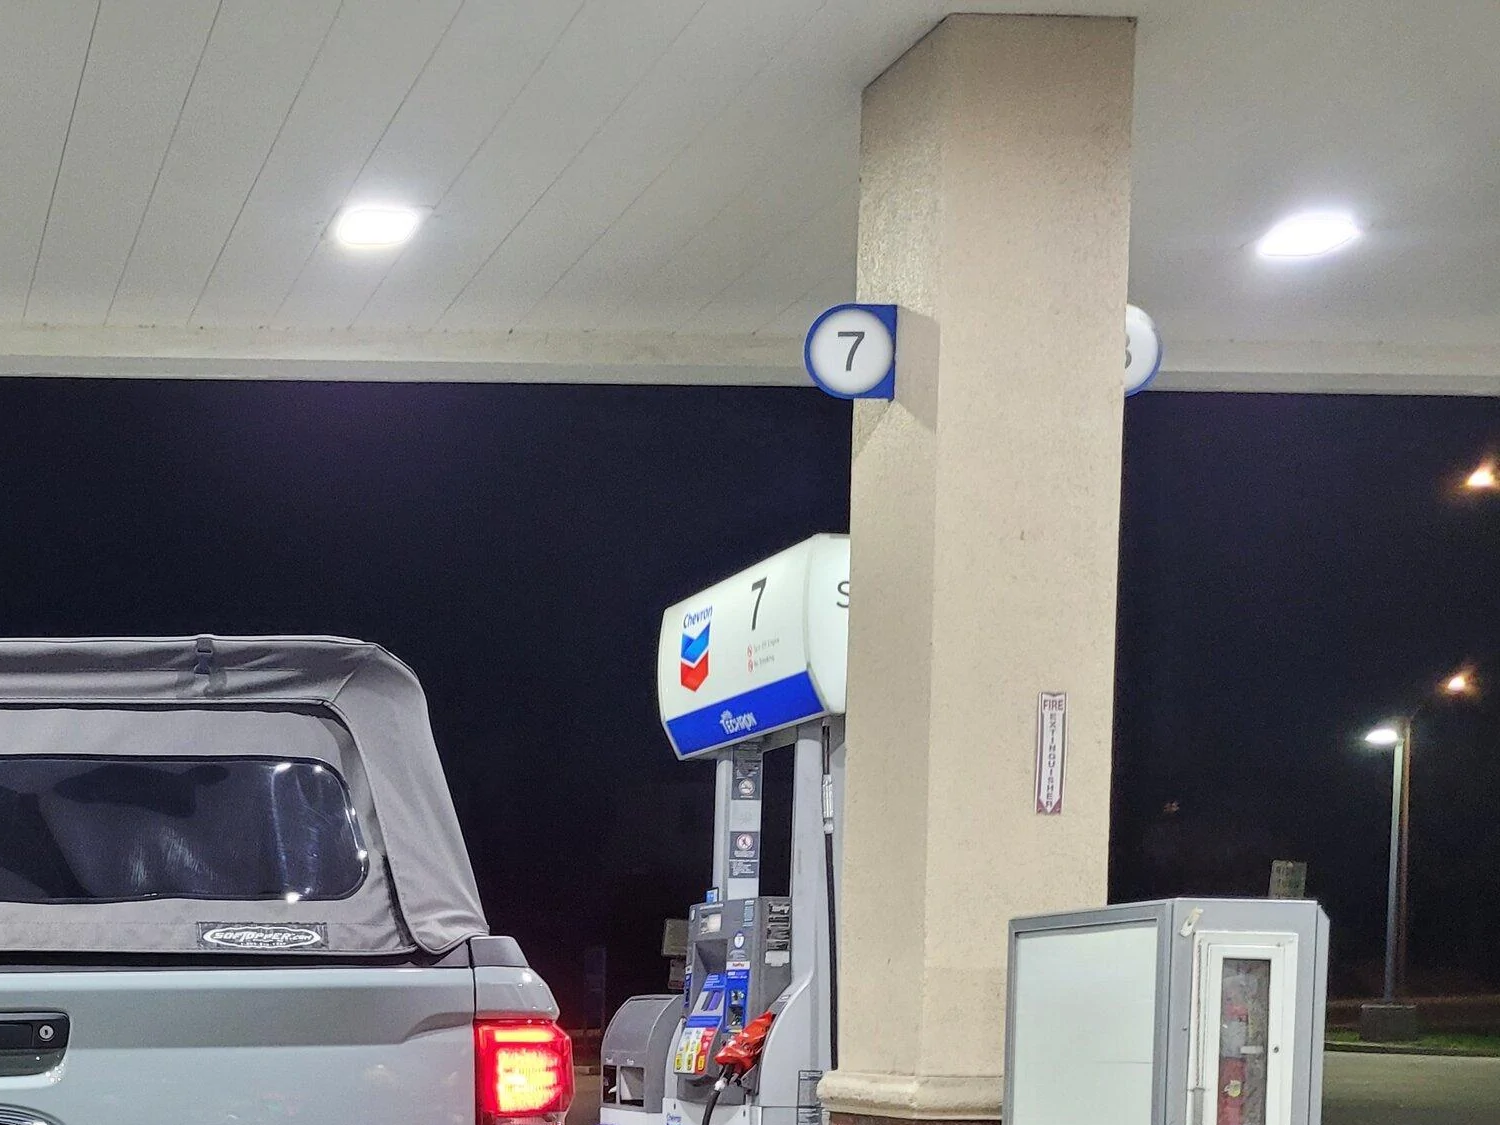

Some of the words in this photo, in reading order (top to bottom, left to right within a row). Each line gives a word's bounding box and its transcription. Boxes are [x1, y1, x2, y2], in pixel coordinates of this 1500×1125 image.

[837, 331, 866, 372] 7
[683, 605, 713, 628] Chevron
[751, 577, 768, 631] 7
[1043, 699, 1064, 711] FIRE
[1046, 713, 1056, 807] EXTINGUISHER
